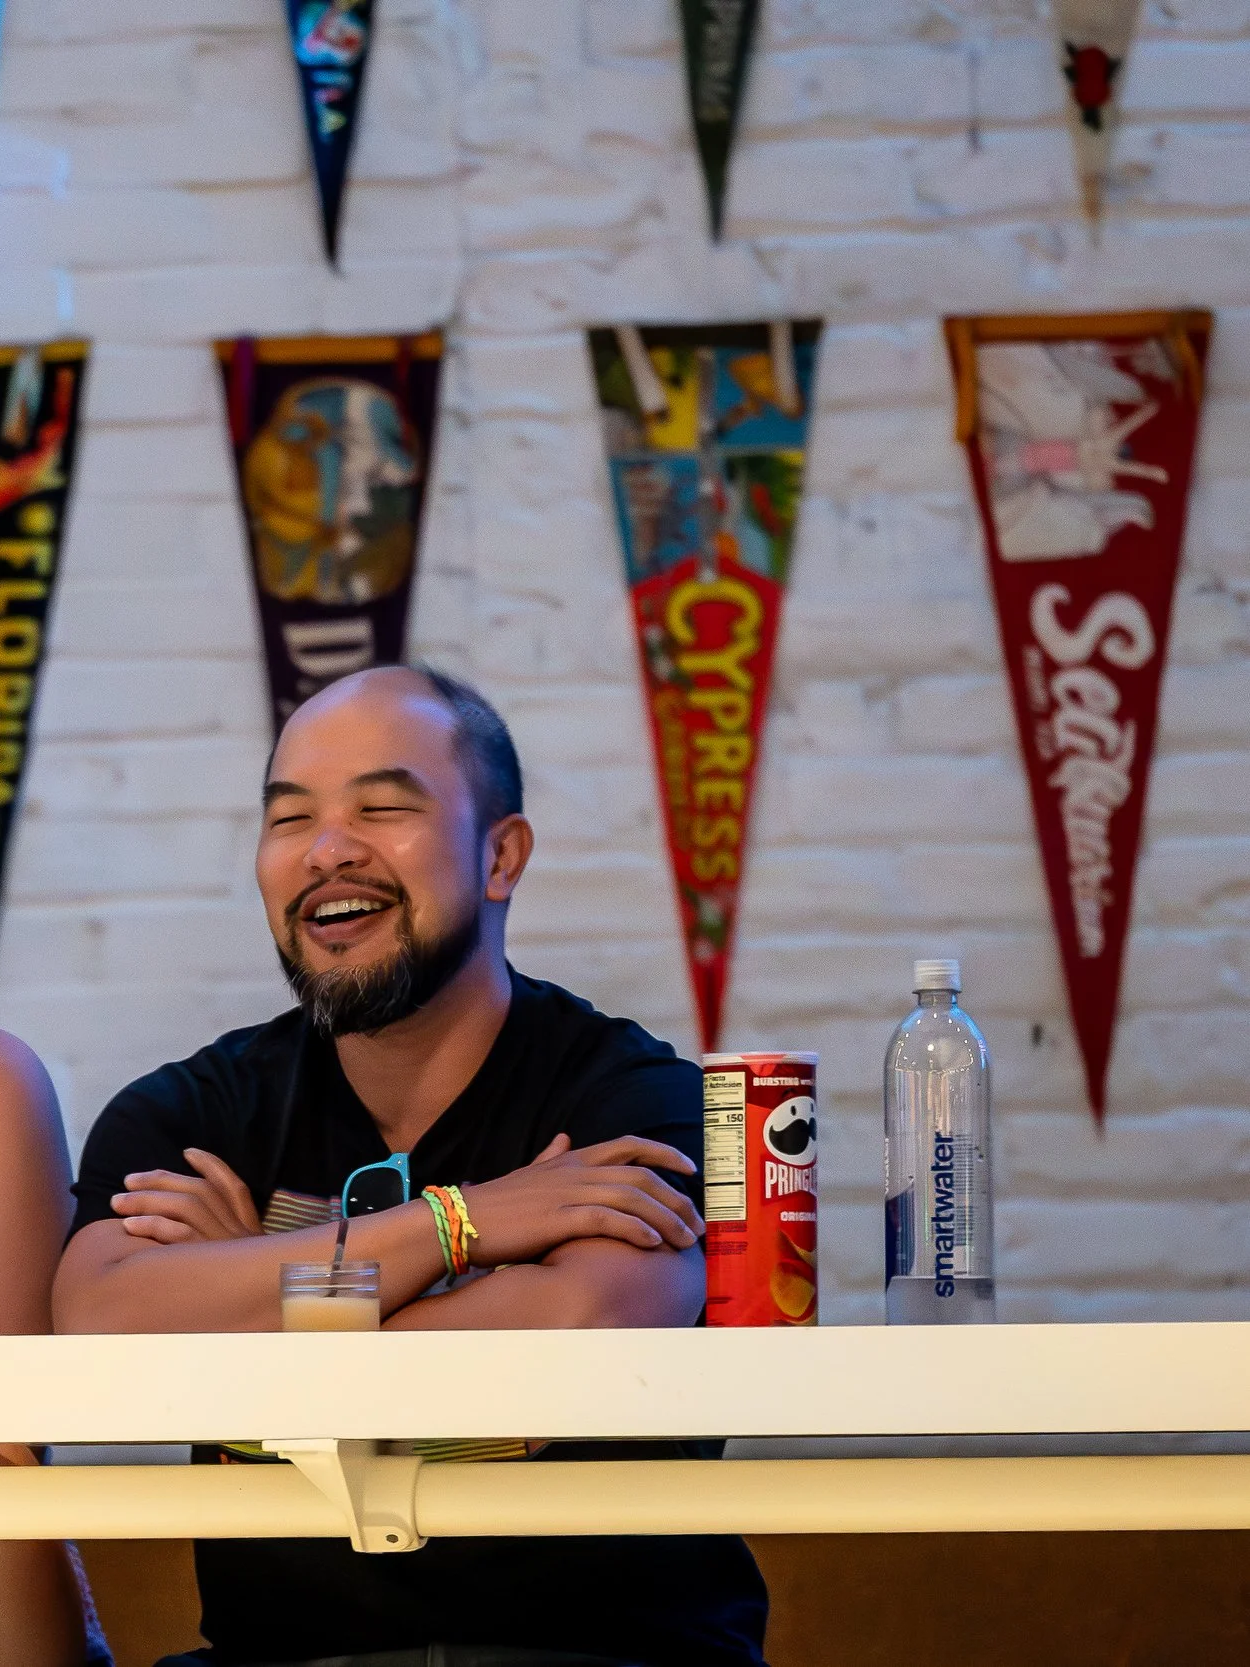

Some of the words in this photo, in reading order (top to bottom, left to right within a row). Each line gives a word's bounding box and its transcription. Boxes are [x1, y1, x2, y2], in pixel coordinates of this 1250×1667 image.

[666, 579, 763, 880] CYPRESS
[726, 1114, 744, 1123] 150
[931, 1130, 955, 1298] smartwater
